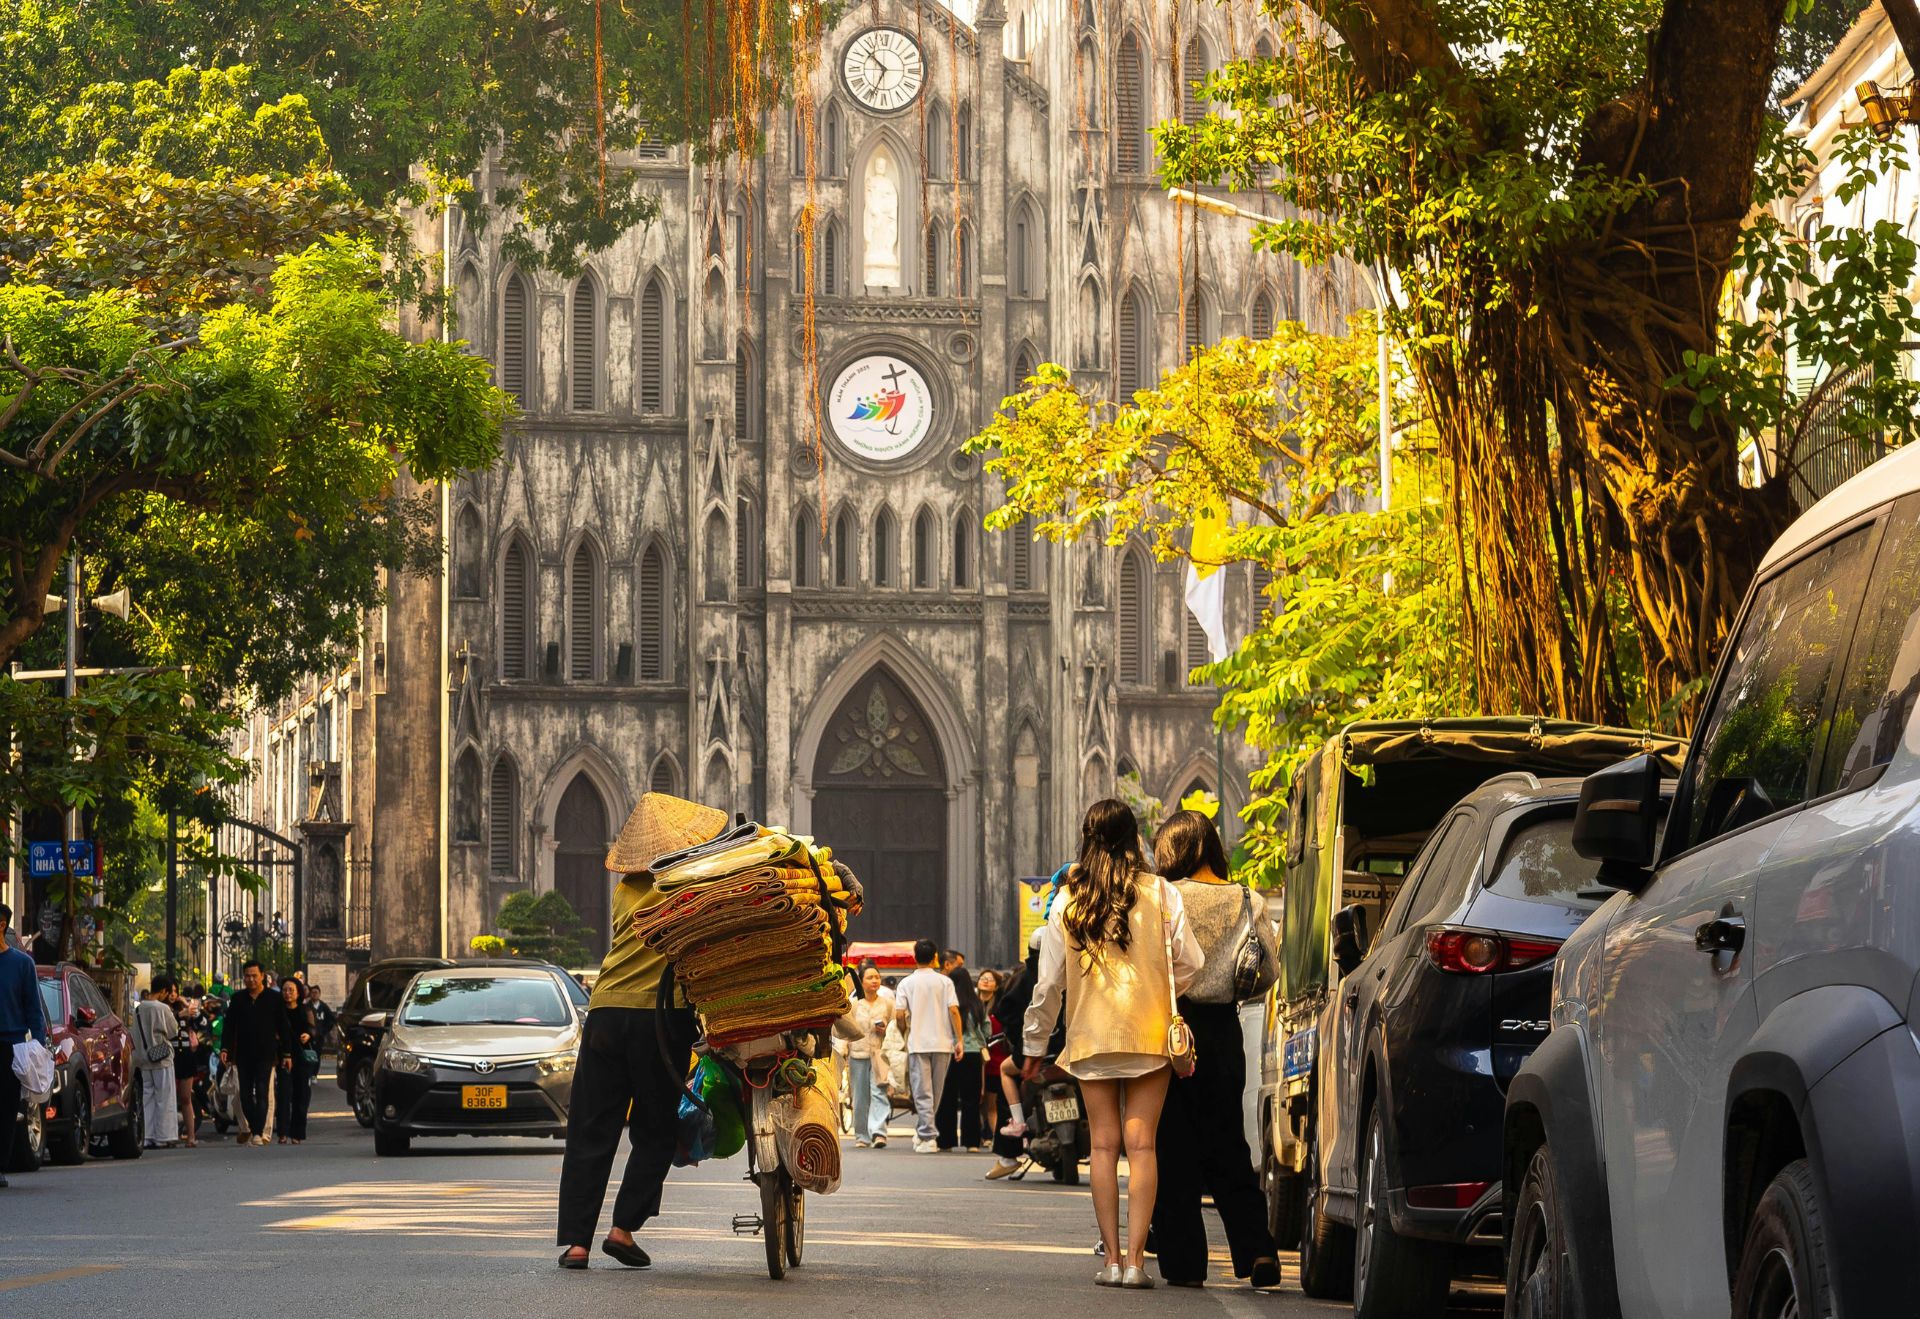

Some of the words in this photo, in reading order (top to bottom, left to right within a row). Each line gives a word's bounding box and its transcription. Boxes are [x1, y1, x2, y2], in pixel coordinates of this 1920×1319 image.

[1343, 889, 1395, 899] SUZU
[1500, 1019, 1551, 1031] CX-5
[475, 1087, 494, 1097] 30F
[467, 1097, 502, 1107] 838.65
